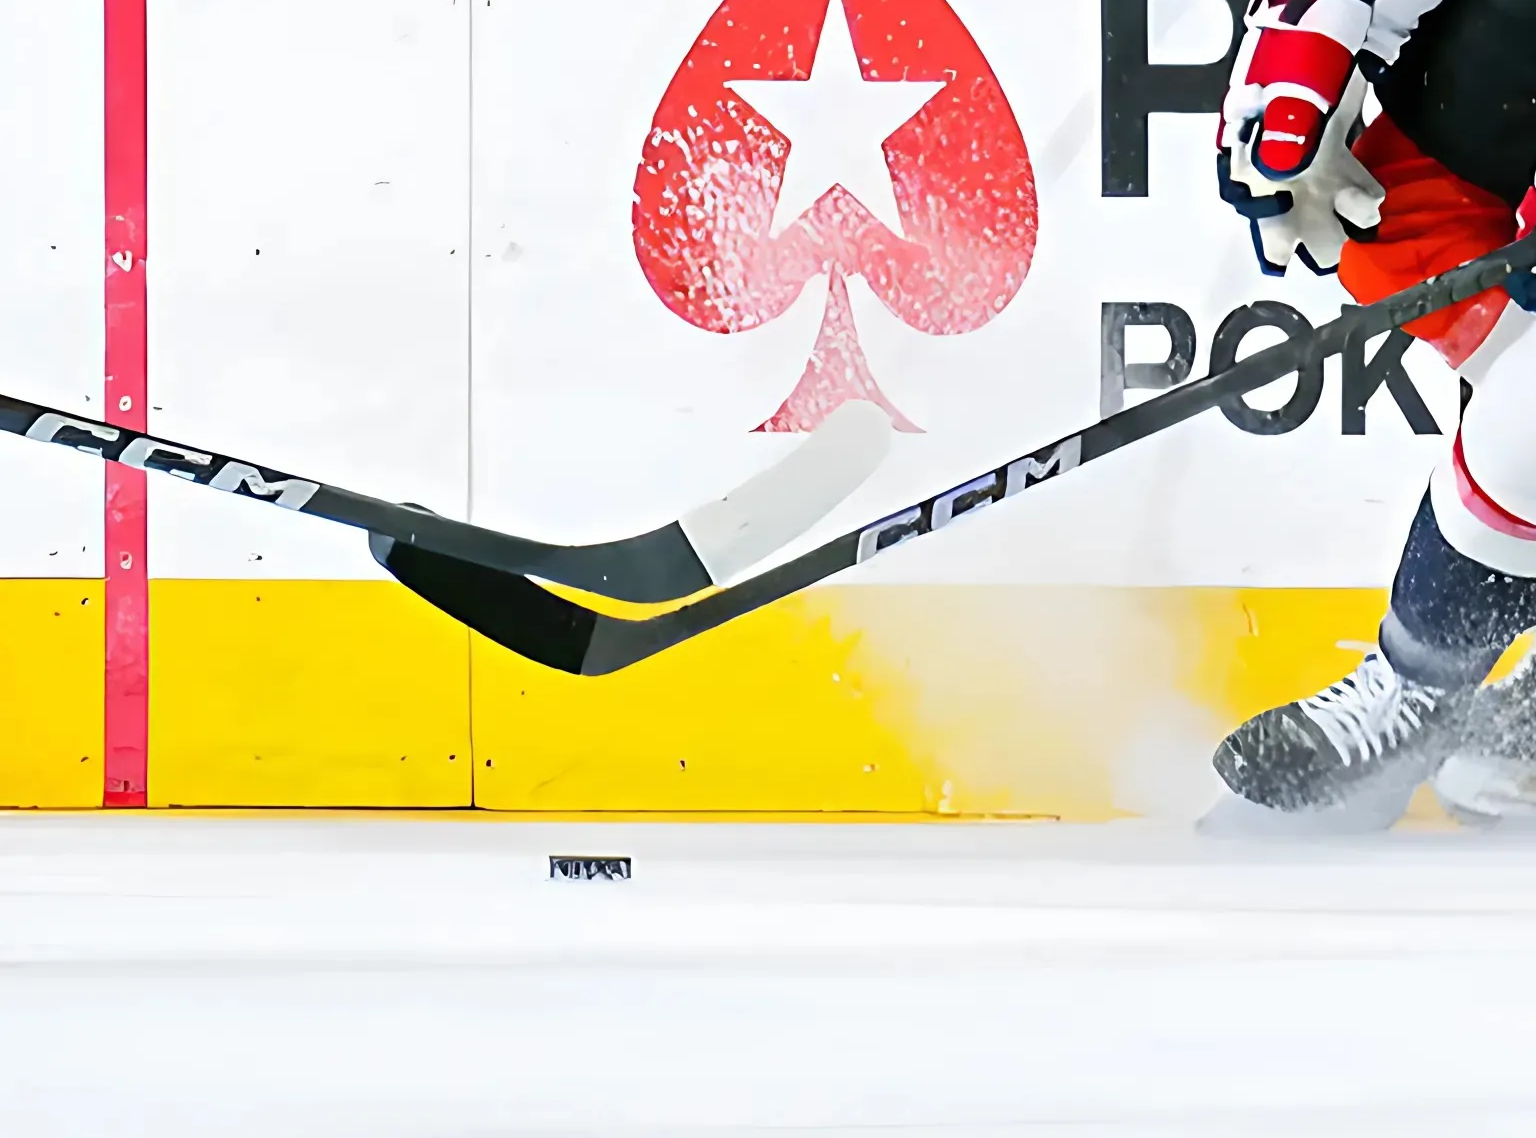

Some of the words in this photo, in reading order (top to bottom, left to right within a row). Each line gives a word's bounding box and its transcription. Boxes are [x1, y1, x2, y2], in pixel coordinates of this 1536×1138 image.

[1100, 300, 1444, 436] POK
[25, 412, 321, 512] CCM
[856, 434, 1082, 566] CCM
